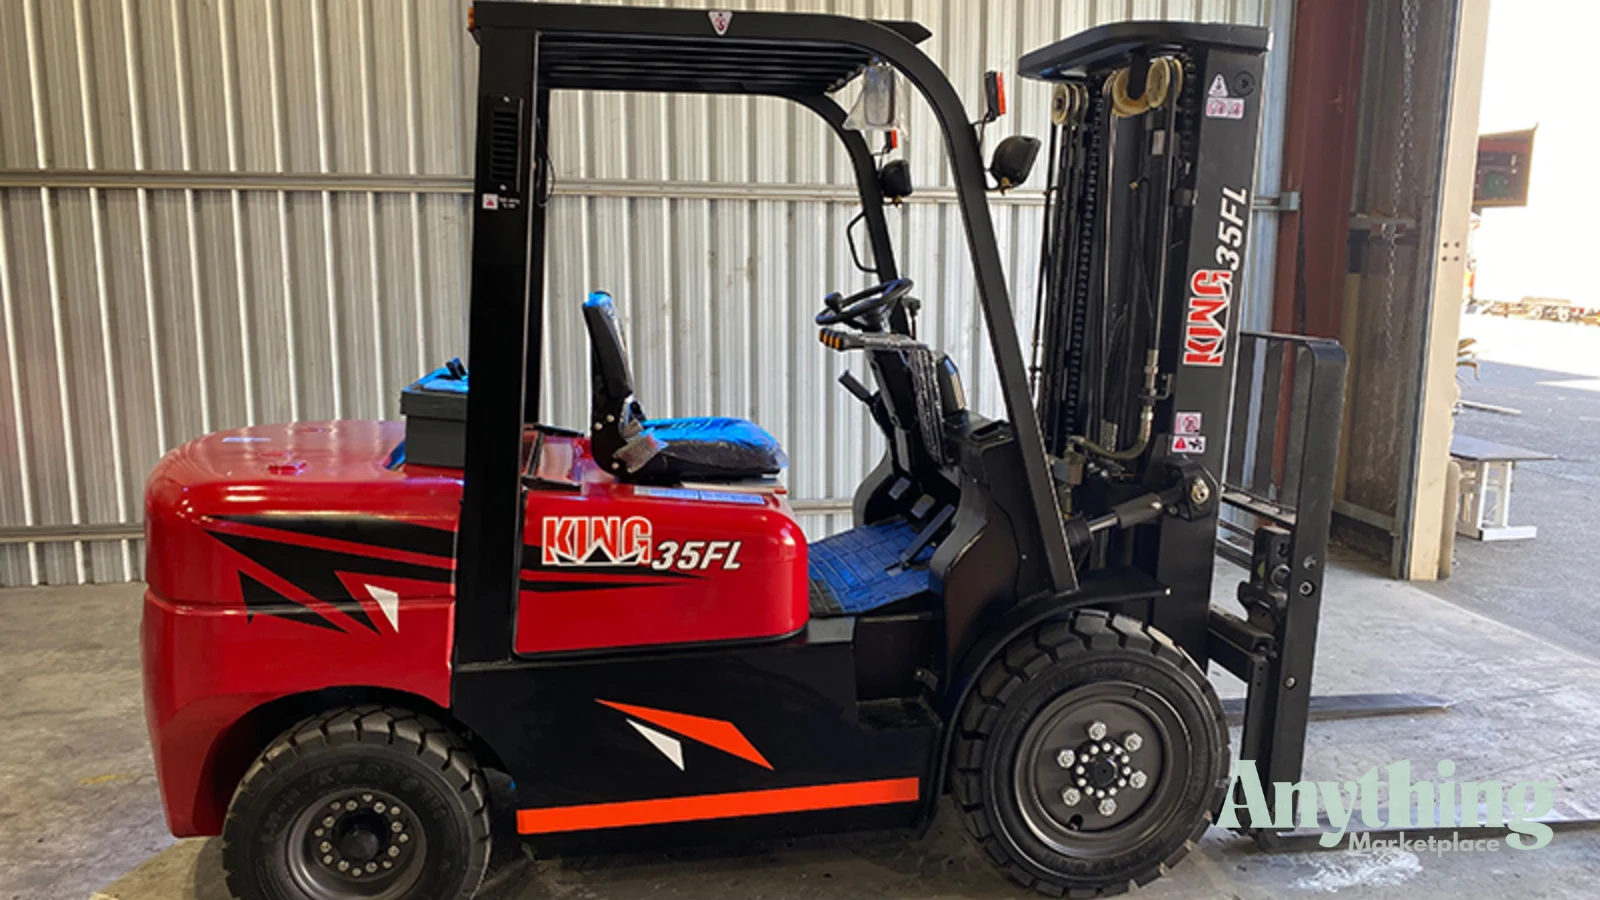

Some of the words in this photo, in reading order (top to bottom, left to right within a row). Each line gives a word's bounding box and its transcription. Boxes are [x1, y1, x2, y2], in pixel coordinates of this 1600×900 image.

[1183, 269, 1232, 367] KING
[1216, 187, 1247, 271] 35FL
[542, 516, 652, 566] KING
[652, 541, 741, 570] 35FL
